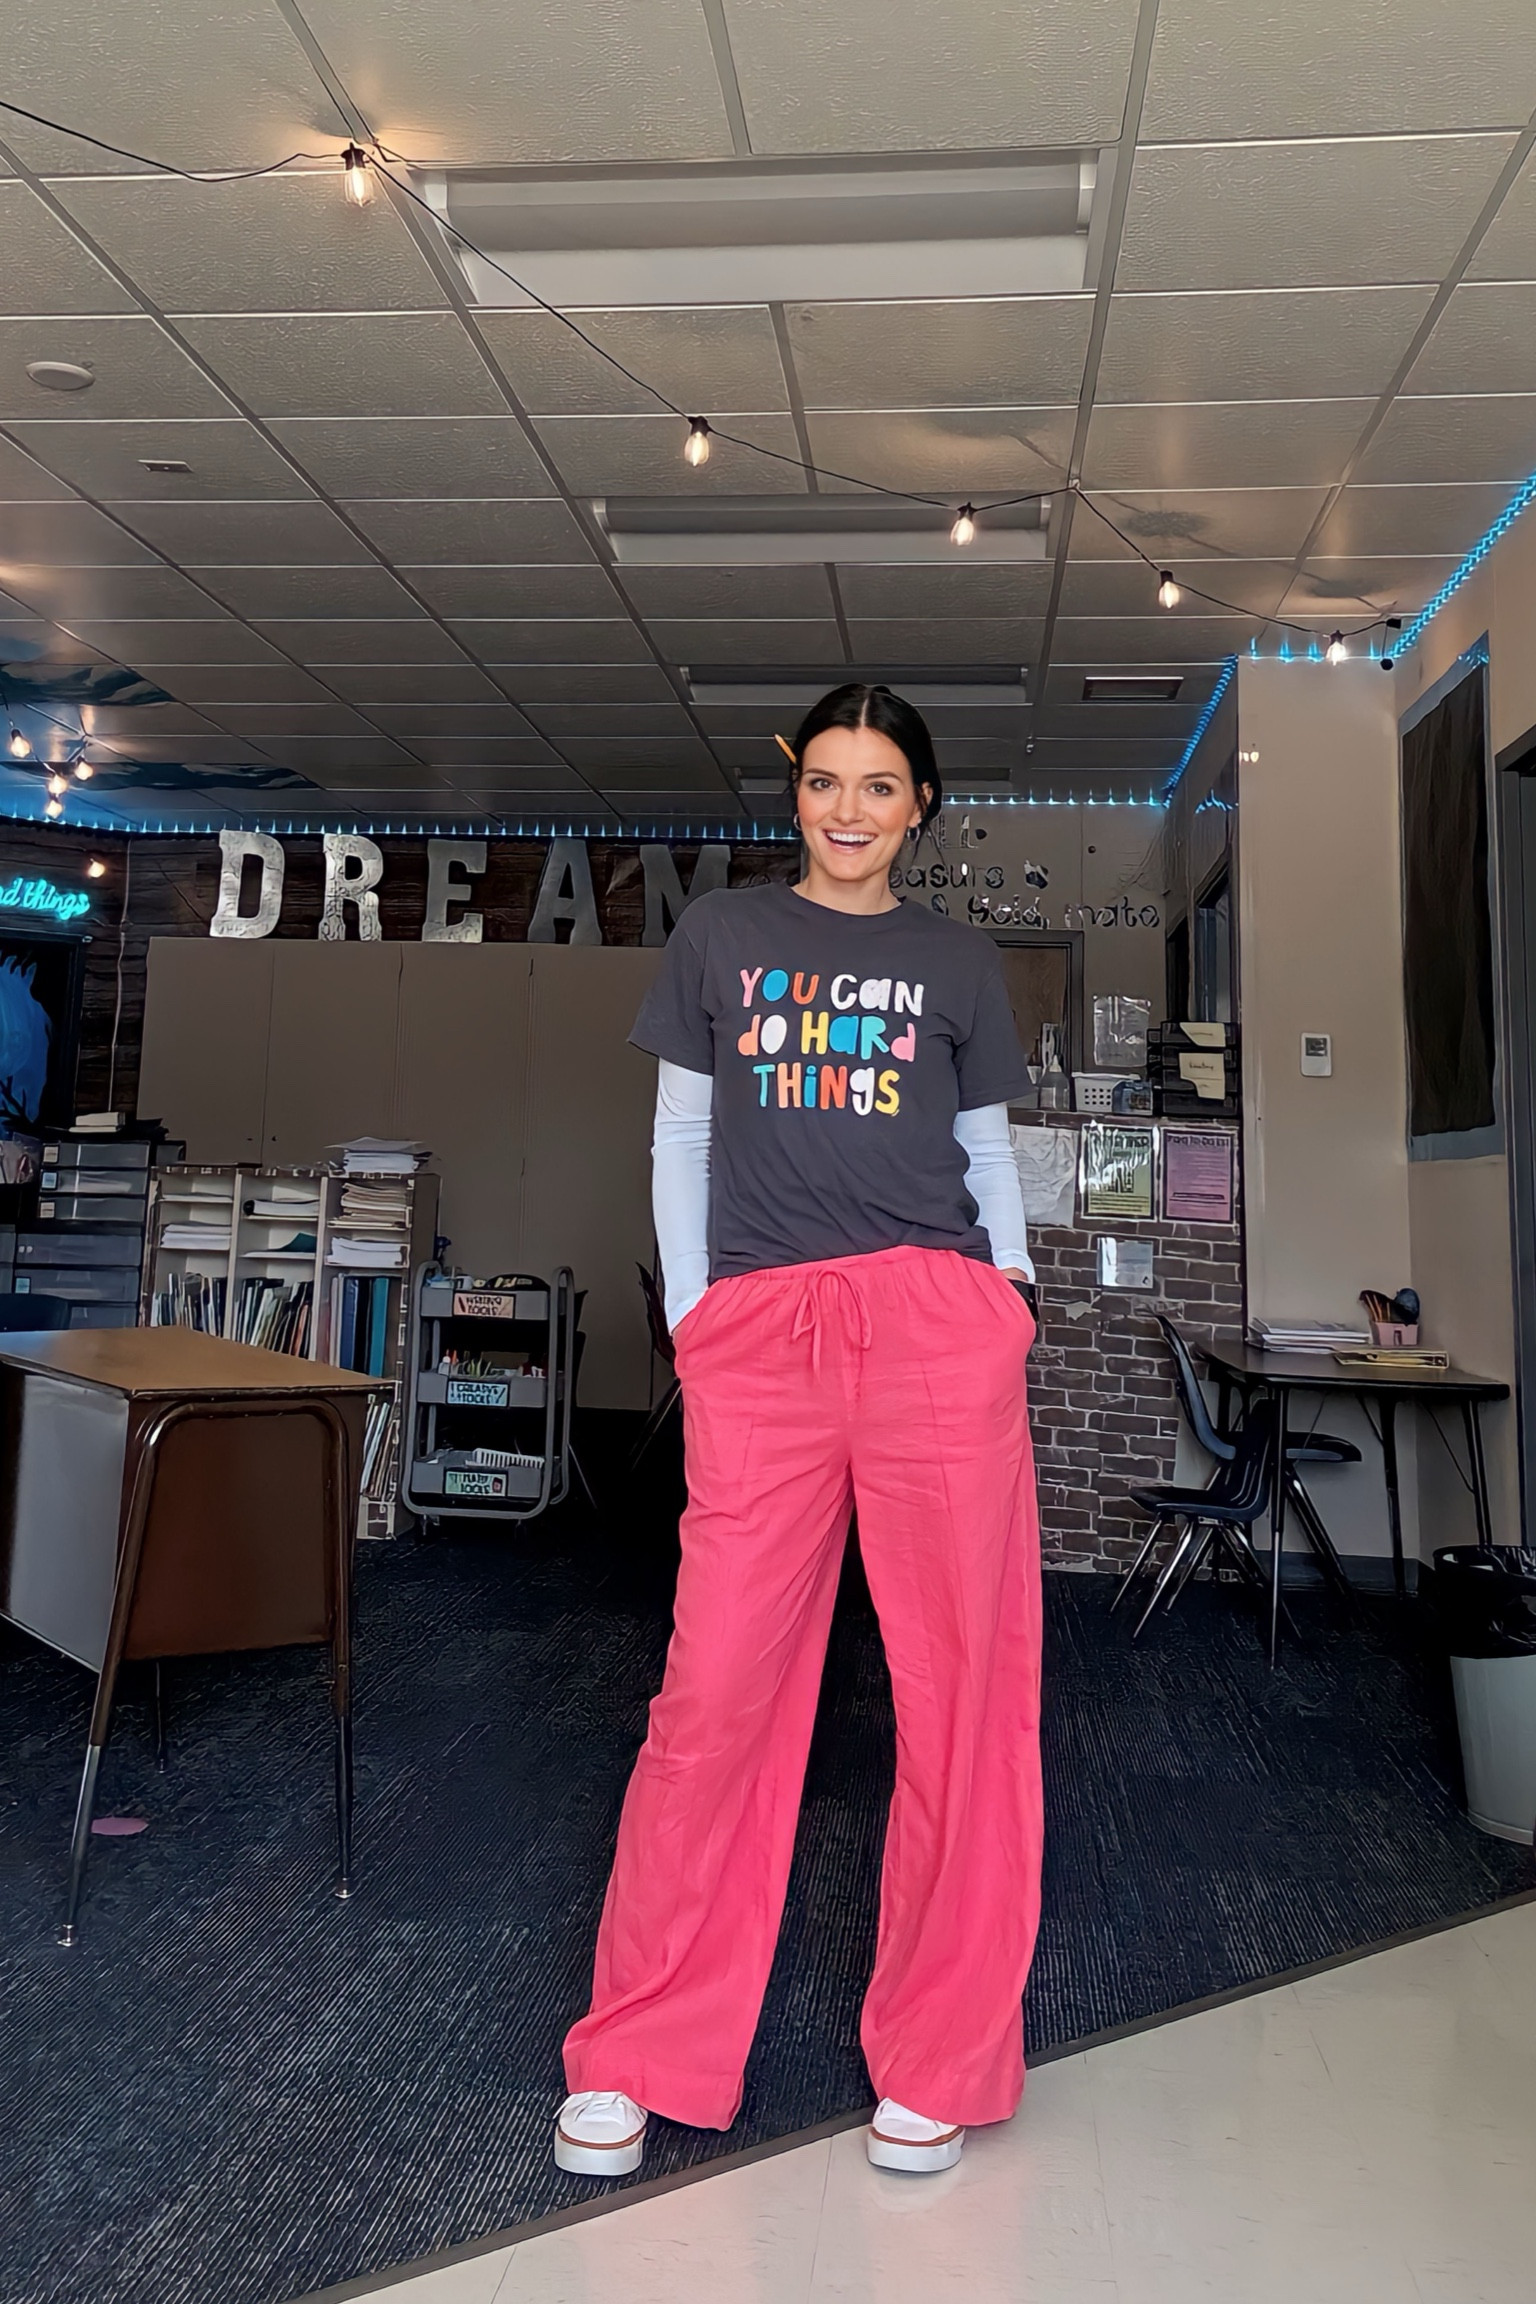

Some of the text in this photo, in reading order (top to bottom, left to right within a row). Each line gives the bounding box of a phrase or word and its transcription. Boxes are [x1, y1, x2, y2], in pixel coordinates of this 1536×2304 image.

[22, 878, 91, 920] things
[209, 829, 731, 946] DREAM
[739, 967, 819, 1008] YOU
